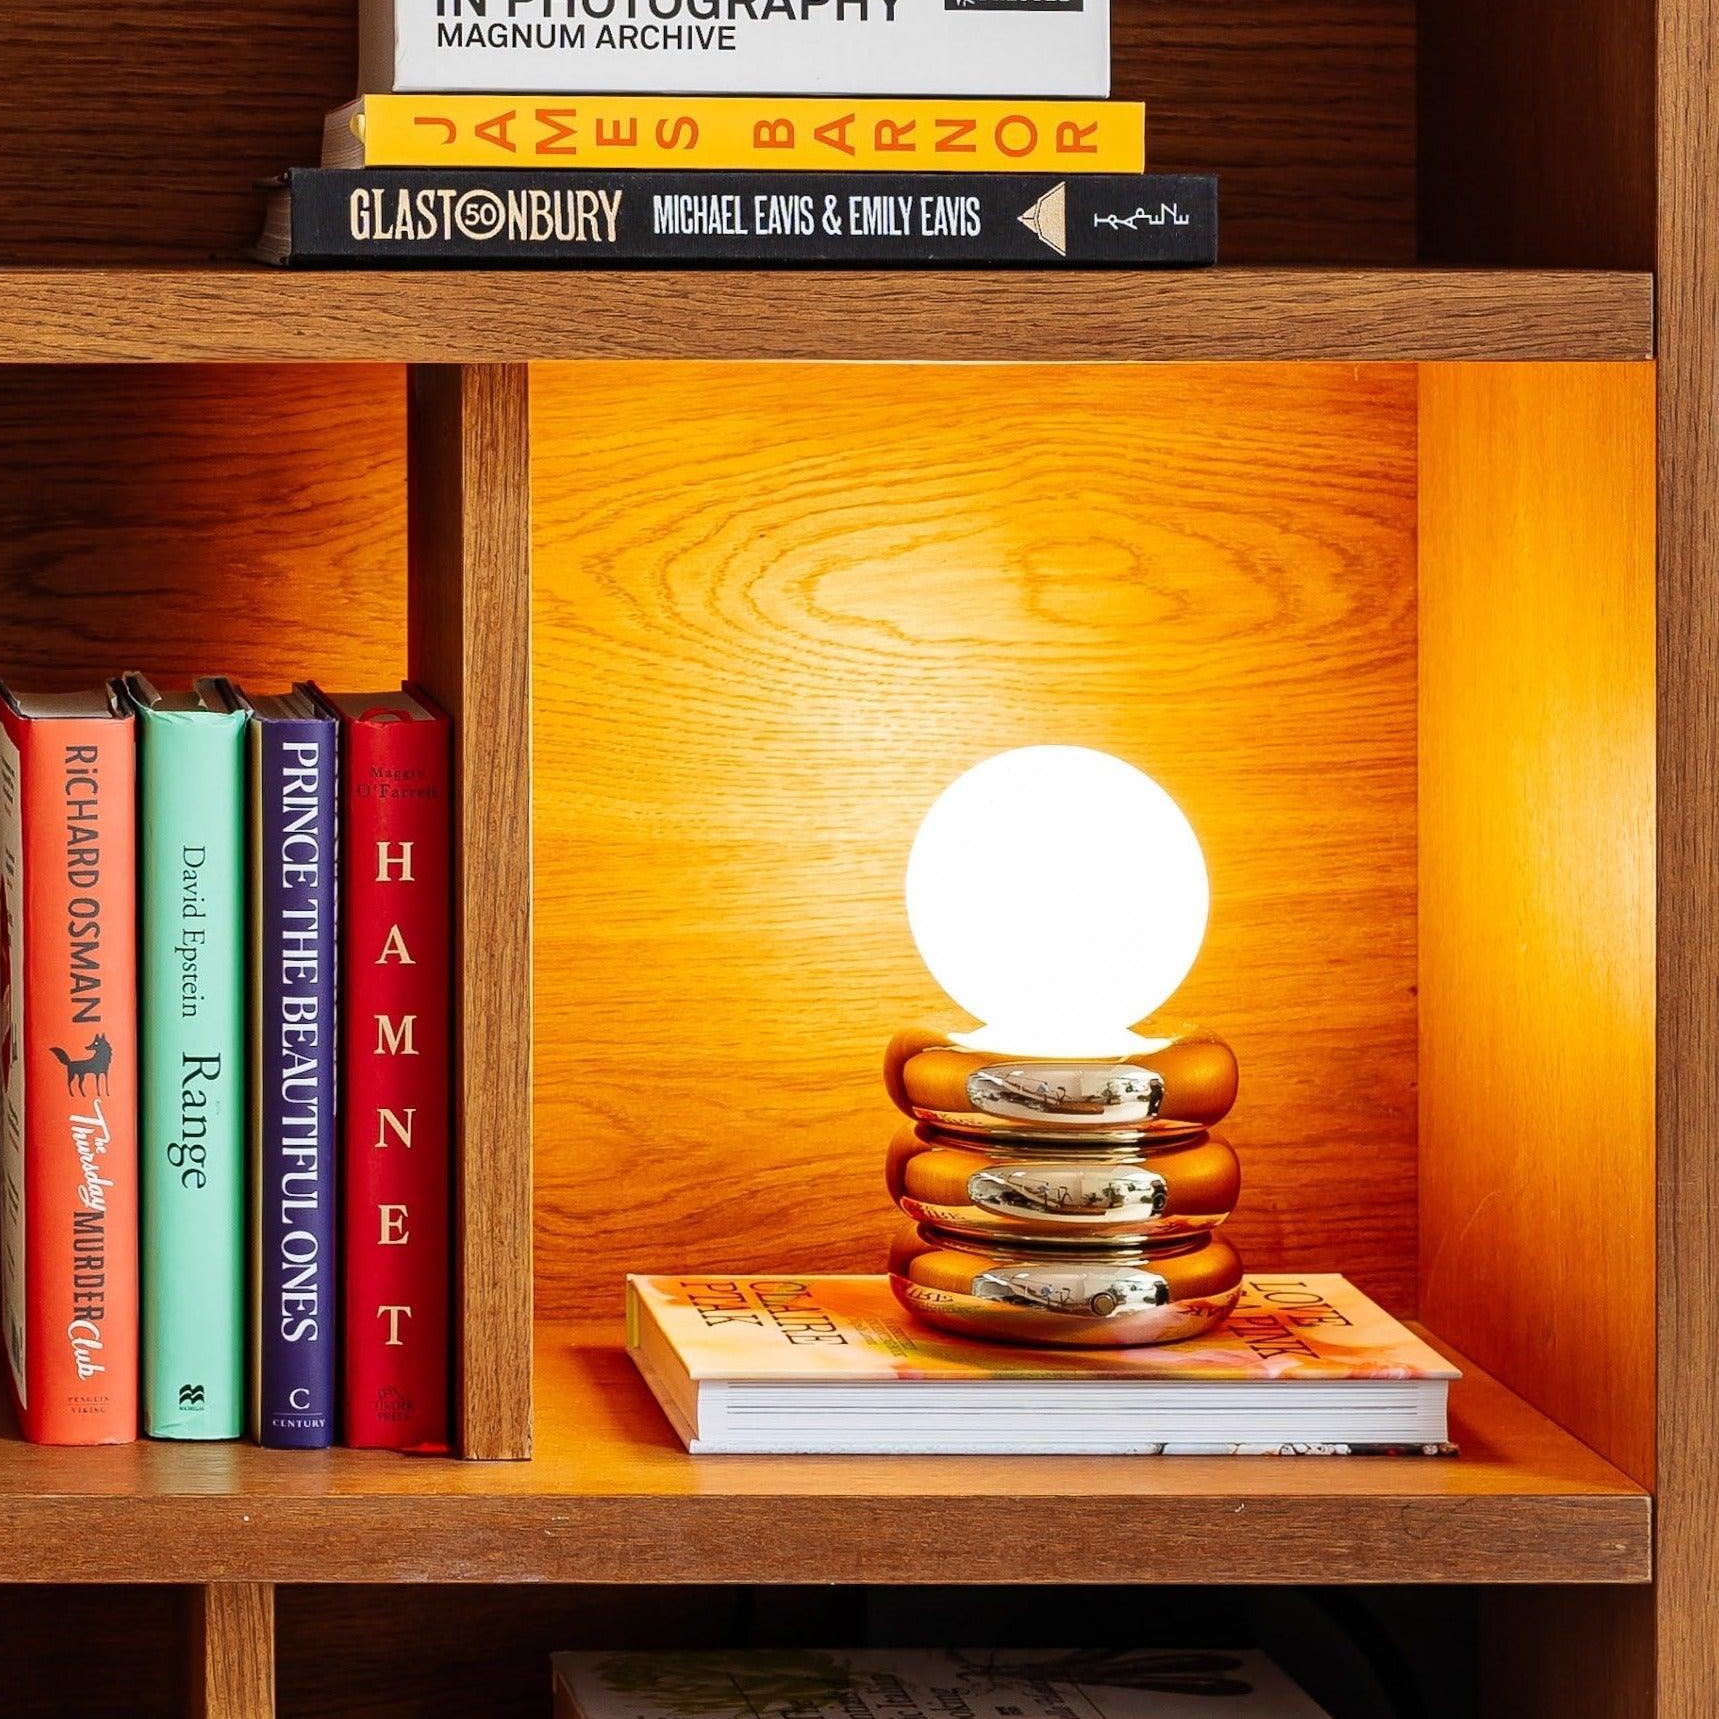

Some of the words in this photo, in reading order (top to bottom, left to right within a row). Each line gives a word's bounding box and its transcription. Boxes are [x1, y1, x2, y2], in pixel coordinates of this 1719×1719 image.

[437, 22, 585, 49] MAGNUM
[595, 24, 737, 51] ARCHIVE
[414, 107, 699, 156] JAMES
[753, 112, 1098, 158] BARNOR
[653, 194, 748, 236] MICHAEL
[755, 194, 815, 236] EAVIS
[822, 194, 842, 237] &
[848, 195, 913, 237] EMILY
[920, 195, 981, 237] EAVIS
[1093, 202, 1190, 231] TRAPEZE
[282, 741, 320, 889] PRINCE
[182, 845, 206, 918] David
[67, 897, 102, 1024] OSMAN
[174, 929, 206, 1019] Epstein
[282, 899, 319, 985] THE
[166, 1051, 222, 1190] Range
[281, 997, 319, 1225] BEAUTIFUL
[373, 841, 420, 1346] HAMNET
[68, 1098, 114, 1212] Thursday
[73, 1210, 105, 1321] MURDER
[281, 1230, 319, 1343] ONES
[680, 1281, 764, 1327] PTAK
[748, 1280, 849, 1345] CLAIRE
[1248, 1281, 1354, 1327] LOVE
[66, 1319, 105, 1381] Club
[1226, 1314, 1321, 1360] PINK
[68, 1395, 110, 1403] PENGUIN
[71, 1406, 106, 1414] VIKING
[289, 1388, 311, 1410] C
